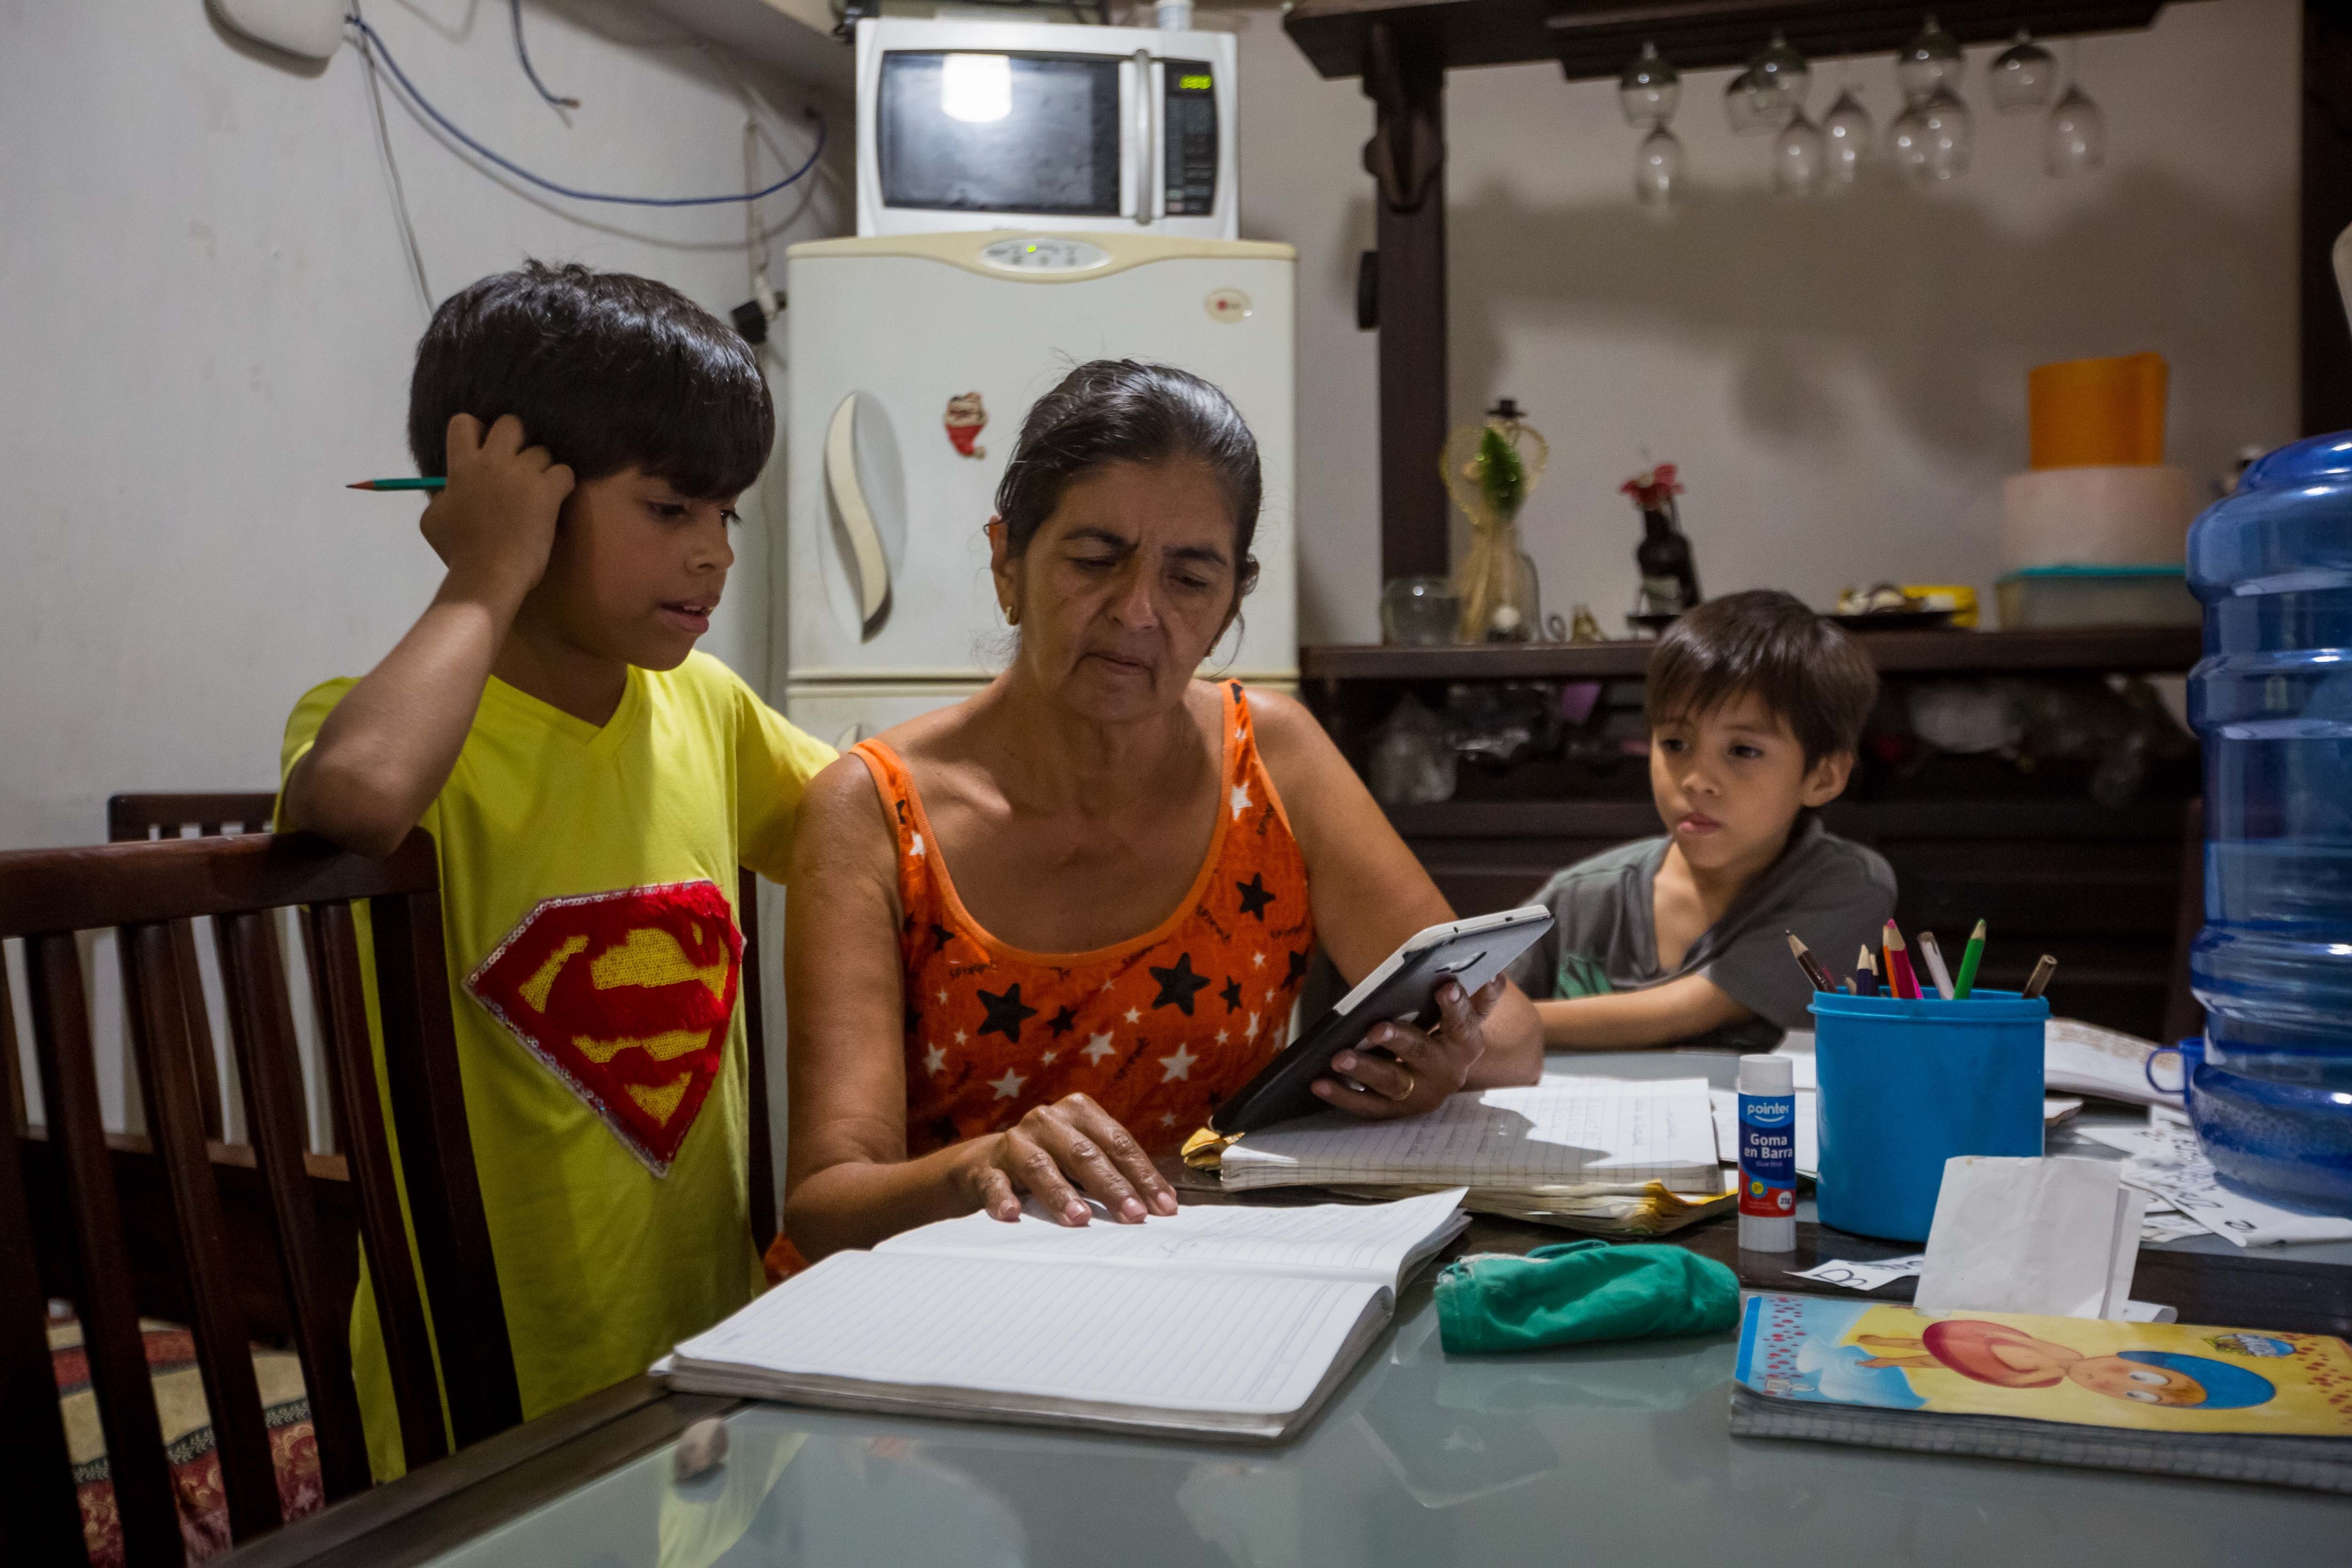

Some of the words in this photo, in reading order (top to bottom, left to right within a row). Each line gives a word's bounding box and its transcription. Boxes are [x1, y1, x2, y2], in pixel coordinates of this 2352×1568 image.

[1748, 1102, 1789, 1115] pointer
[1750, 1133, 1788, 1146] Goma
[1744, 1147, 1758, 1158] en
[1761, 1147, 1793, 1159] Barra
